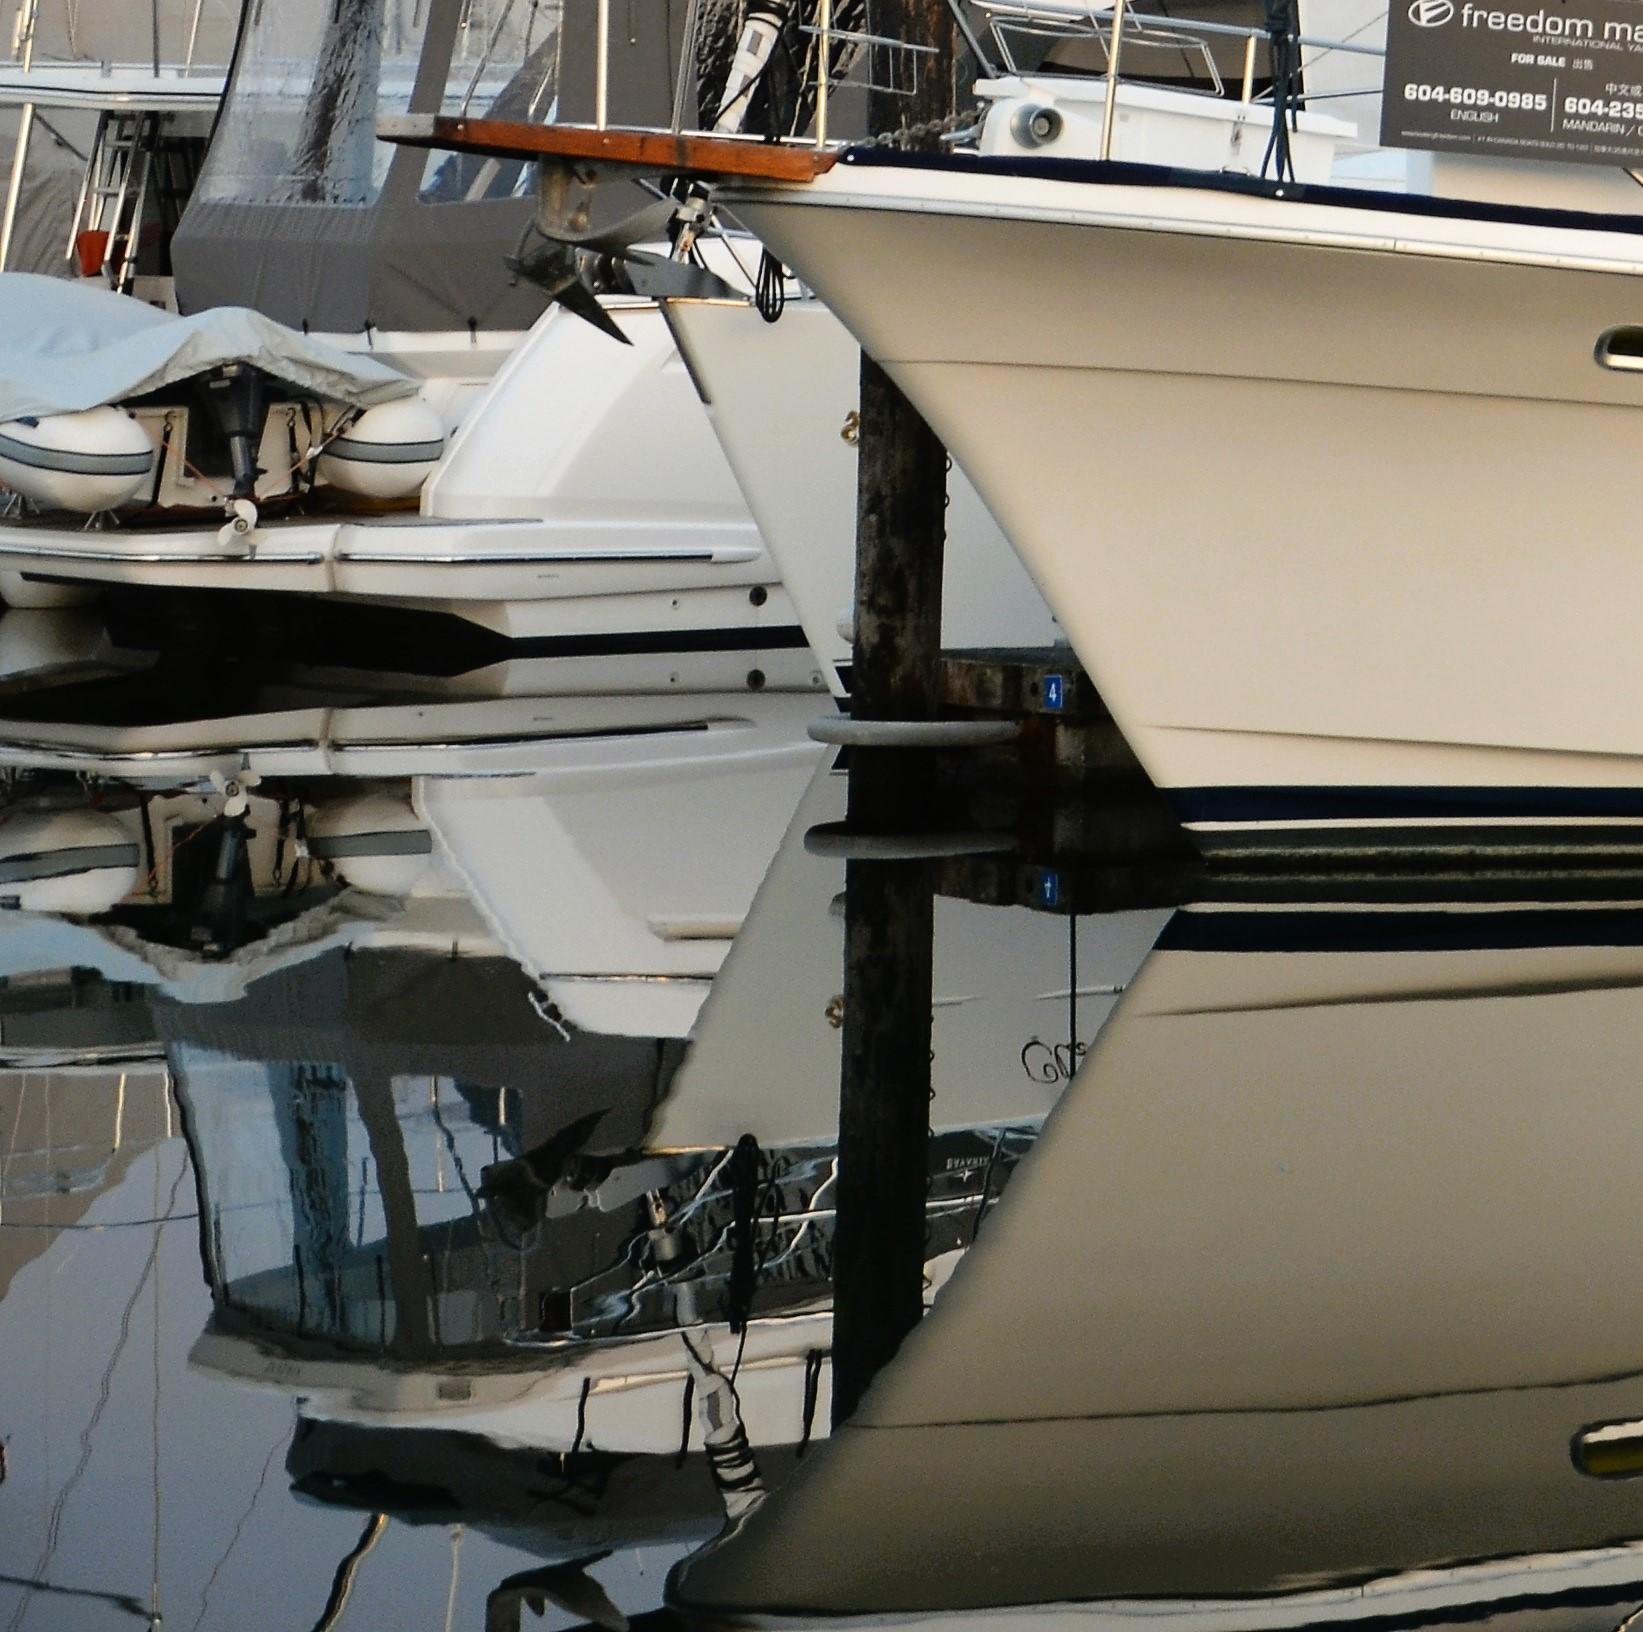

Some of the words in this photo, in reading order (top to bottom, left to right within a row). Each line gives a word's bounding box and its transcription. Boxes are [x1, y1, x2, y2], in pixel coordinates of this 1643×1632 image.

[1461, 3, 1593, 38] freedom
[1532, 35, 1624, 51] INTERNATIONAL
[1511, 52, 1535, 65] FOR
[1536, 54, 1566, 68] SALE
[1404, 83, 1547, 111] 604-609-0985
[1450, 108, 1499, 123] ENGLISH
[1562, 118, 1625, 135] MANDARIN
[1049, 682, 1057, 703] 4
